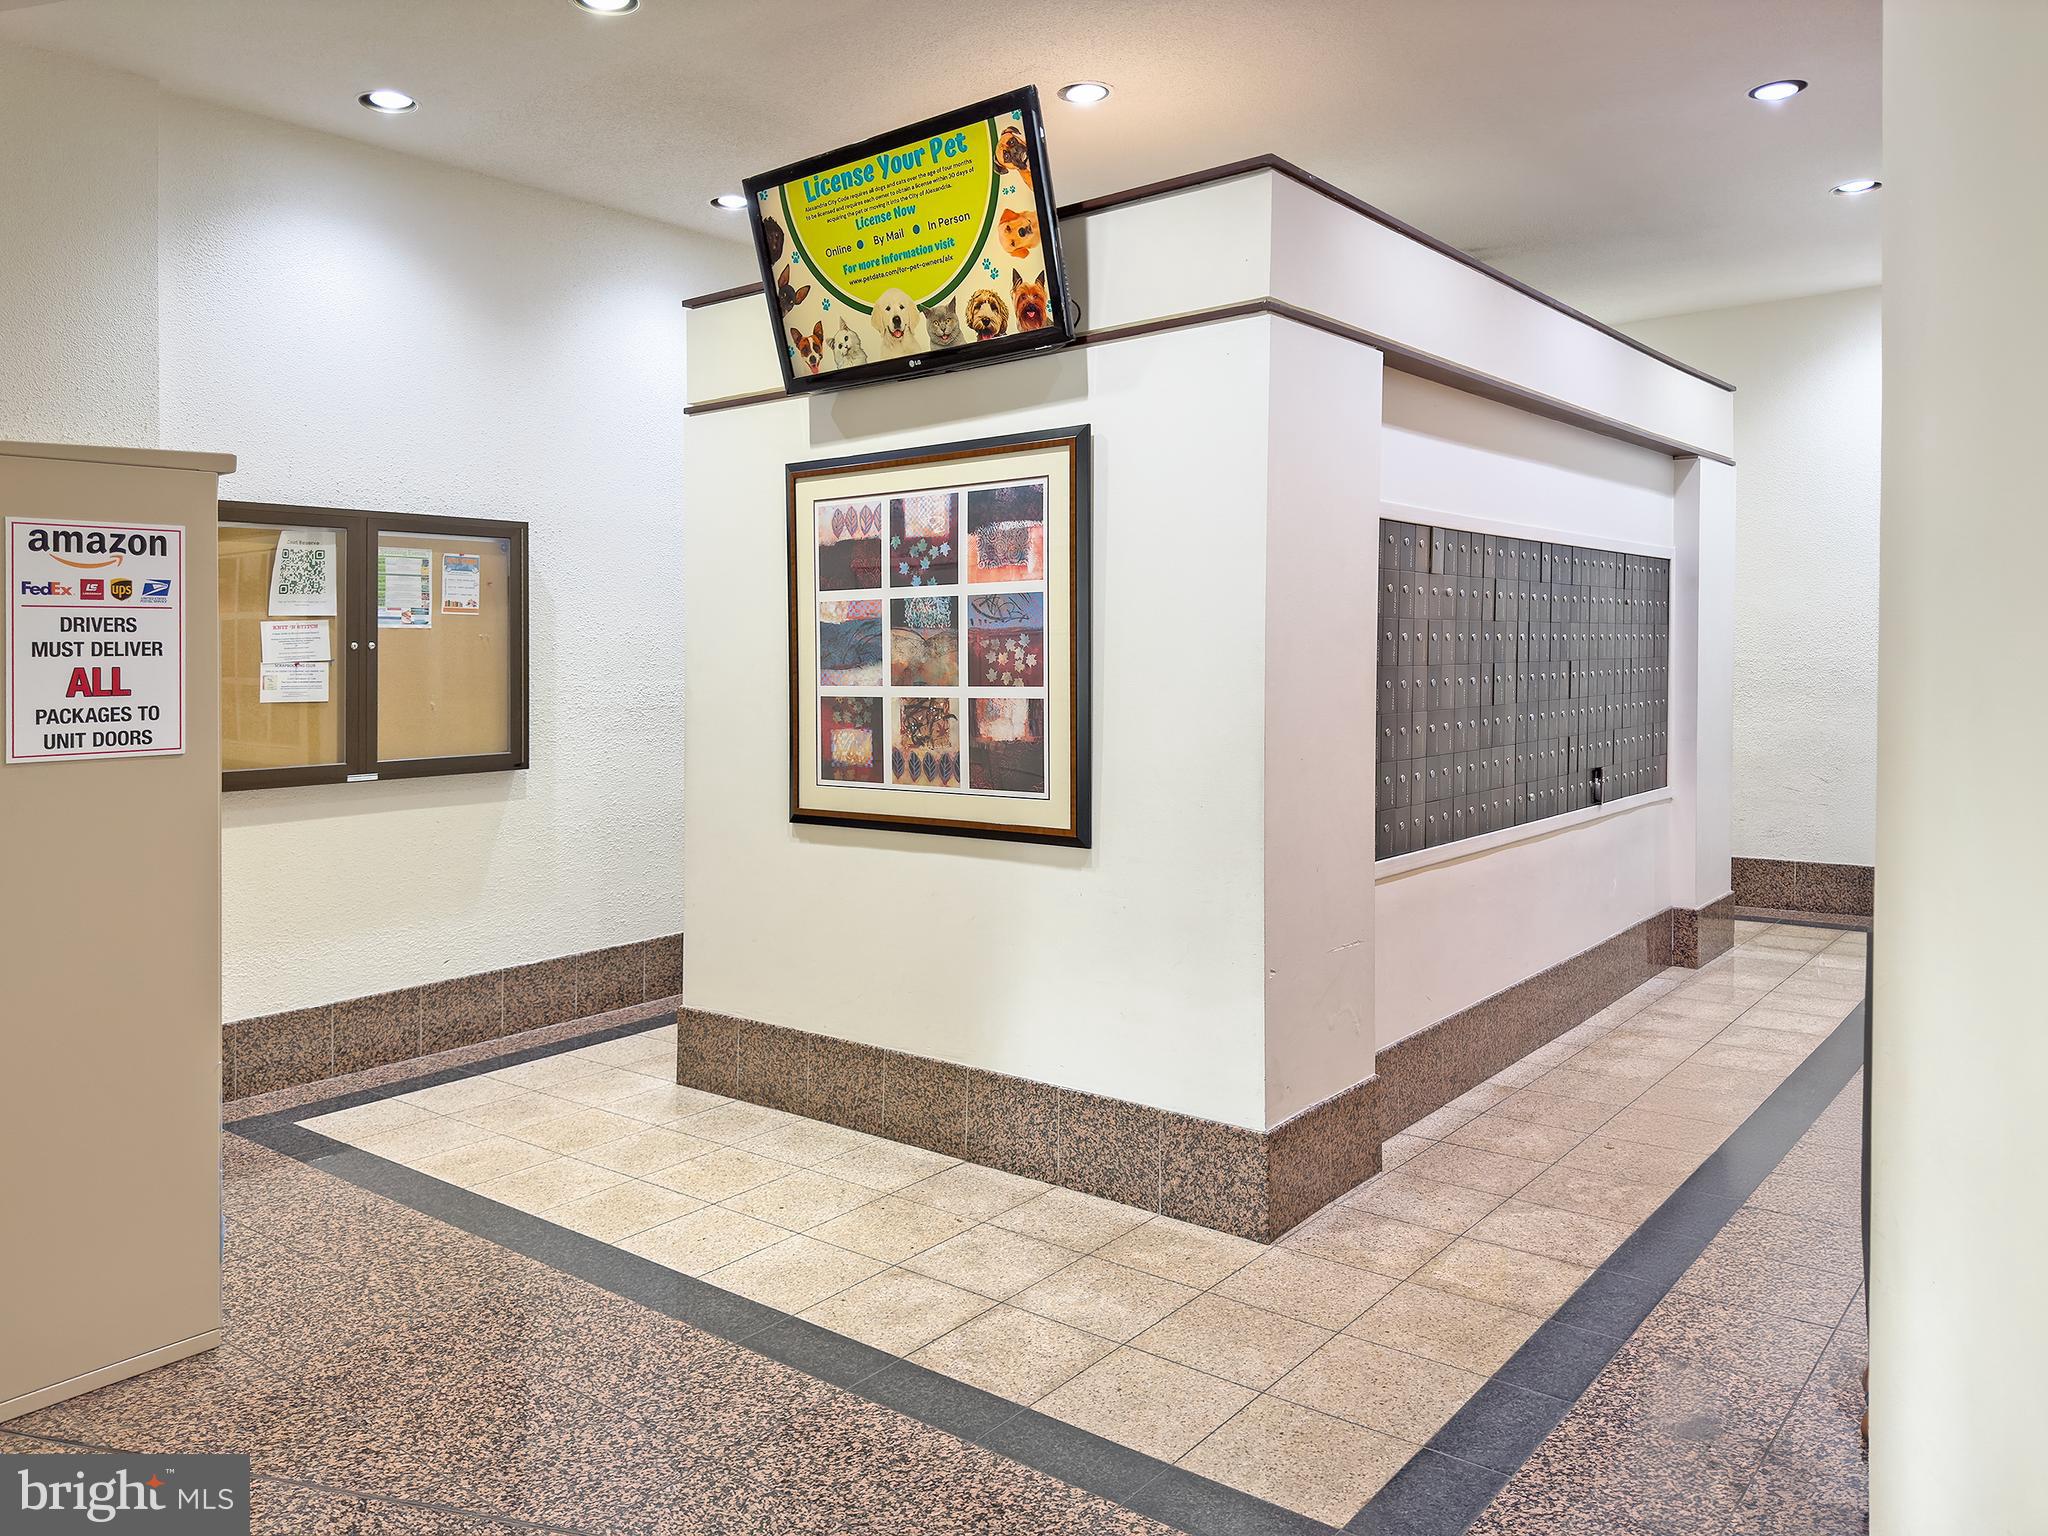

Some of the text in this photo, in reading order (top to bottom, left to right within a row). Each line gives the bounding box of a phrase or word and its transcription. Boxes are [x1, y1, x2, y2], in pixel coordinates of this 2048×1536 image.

[803, 133, 968, 203] License Your Pet
[805, 202, 828, 212] Alexandria
[850, 190, 868, 200] requires
[942, 164, 952, 172] four
[953, 159, 972, 168] months
[817, 208, 836, 218] licensed
[845, 200, 864, 210] requires
[864, 196, 876, 204] each
[896, 185, 911, 194] obtain
[915, 180, 932, 189] license
[933, 175, 948, 184] within
[956, 169, 968, 177] days
[827, 213, 847, 223] acquiring
[855, 208, 864, 216] pet
[869, 202, 886, 211] moving
[908, 192, 919, 200] City
[925, 183, 952, 195] Alexandria.
[855, 205, 916, 230] License Now
[825, 212, 971, 257] Online By Mail In Person
[843, 238, 955, 275] For more information visit
[849, 254, 954, 285] www.petdata.com/for-pet-owners/alx
[28, 529, 167, 556] amazon
[21, 581, 73, 596] FedEx
[86, 583, 98, 591] LS
[112, 585, 133, 598] ups
[60, 617, 137, 632] DRIVERS
[31, 641, 163, 657] MUST DELIVER
[66, 667, 131, 698] ALL
[35, 705, 160, 725] PACKAGES TO
[43, 729, 153, 750] UNIT DOORS
